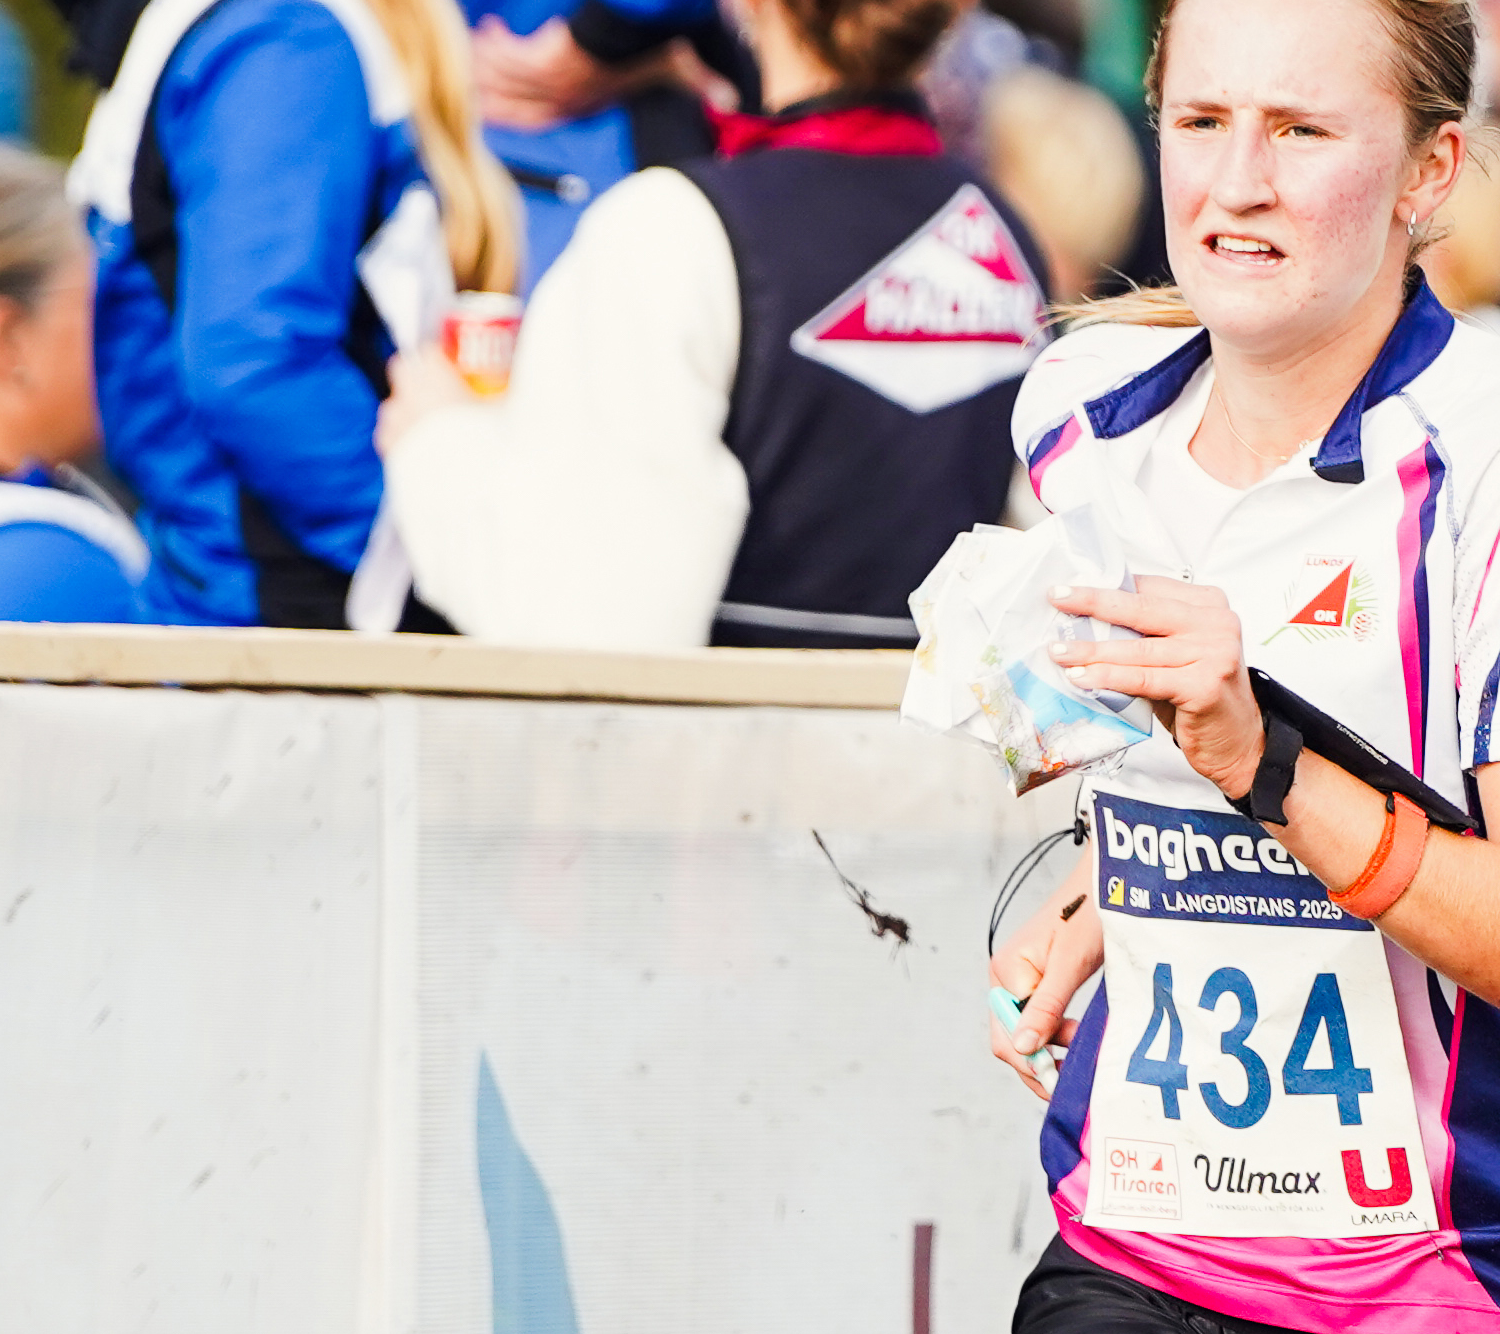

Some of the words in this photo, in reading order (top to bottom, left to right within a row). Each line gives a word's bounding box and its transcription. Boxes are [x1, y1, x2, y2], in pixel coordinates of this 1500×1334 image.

[1306, 557, 1344, 567] LUNDS
[1314, 609, 1338, 623] OK
[1129, 886, 1151, 910] SM
[1300, 899, 1343, 921] 2025
[1126, 963, 1373, 1130] 434
[1110, 1172, 1177, 1196] Tisaren
[1194, 1153, 1321, 1194] Ullmax
[1350, 1211, 1418, 1226] UMARA
